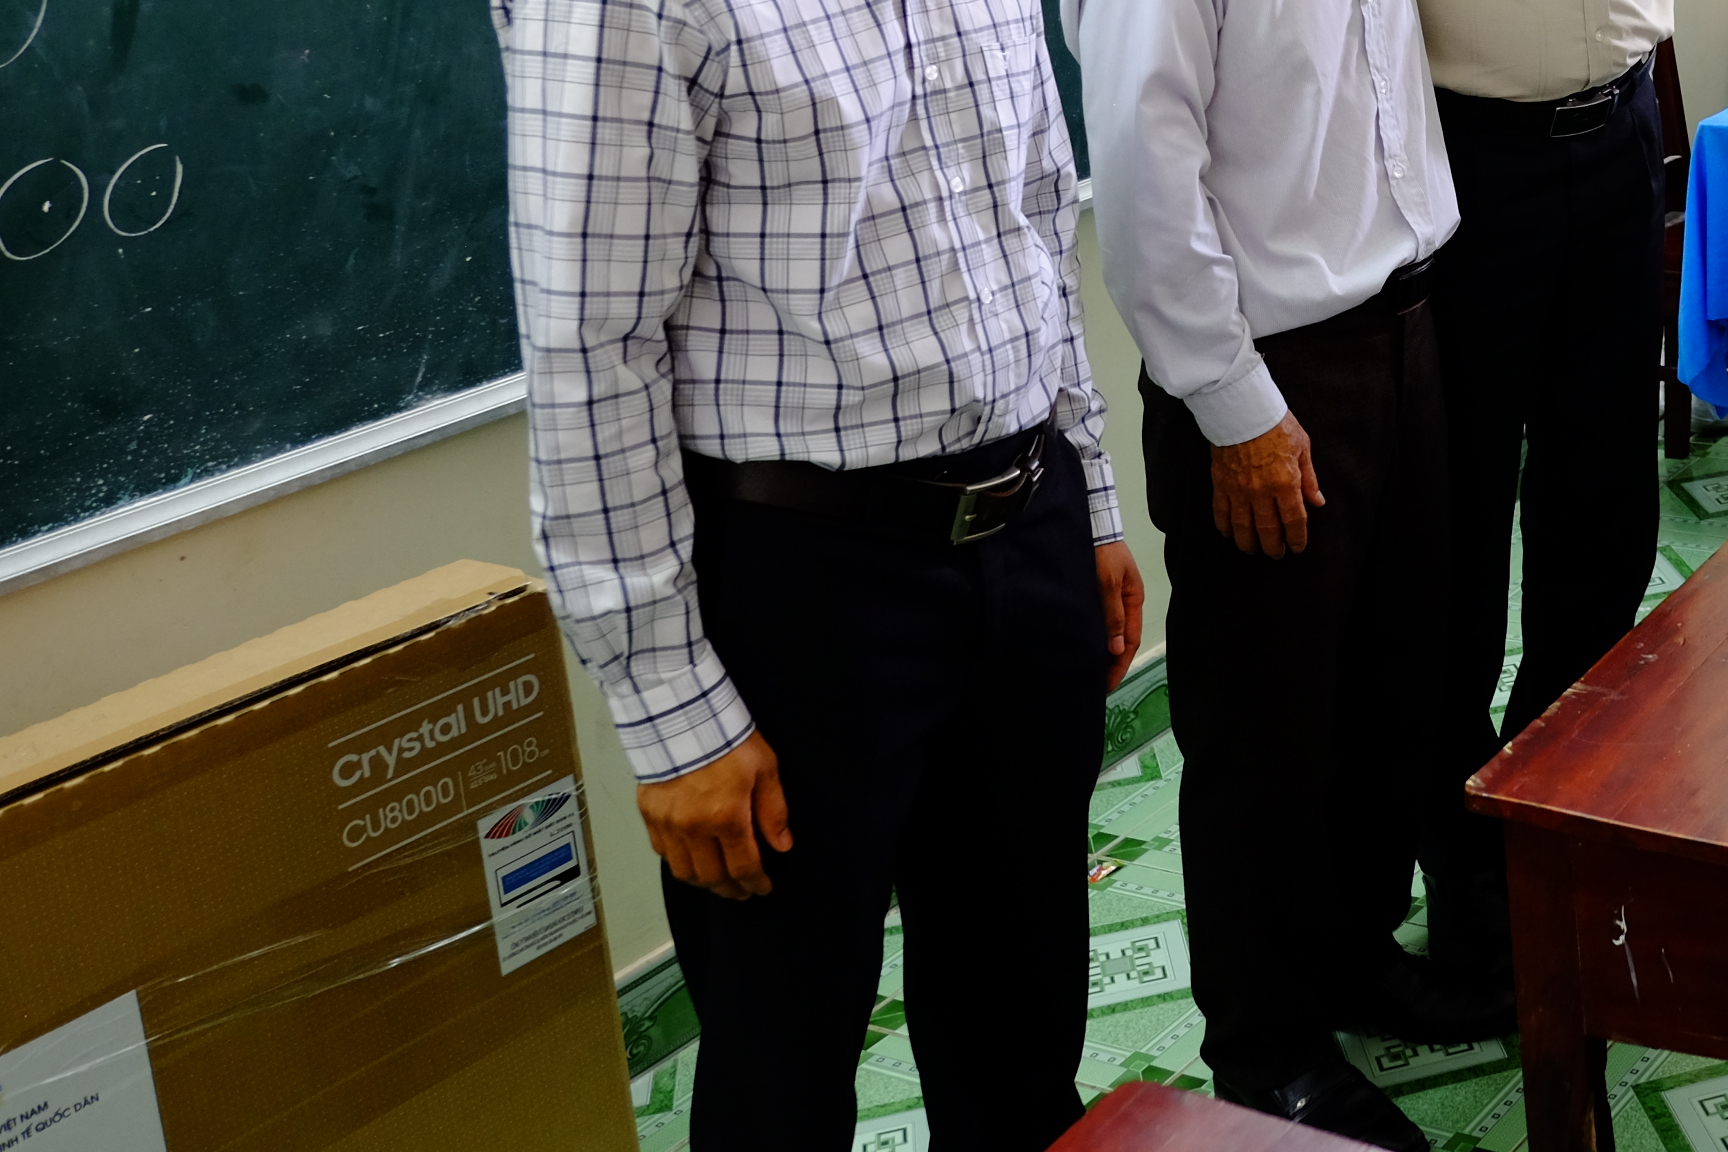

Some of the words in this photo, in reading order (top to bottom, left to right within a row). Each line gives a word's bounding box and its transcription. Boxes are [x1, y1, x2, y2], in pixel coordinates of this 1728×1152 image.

[332, 703, 467, 788] Crystal
[473, 673, 540, 725] UHD
[496, 737, 539, 775] 108
[342, 777, 456, 848] CU8000
[20, 1100, 49, 1123] NAM
[35, 1107, 71, 1133] QUỐC
[73, 1093, 99, 1113] DÂN
